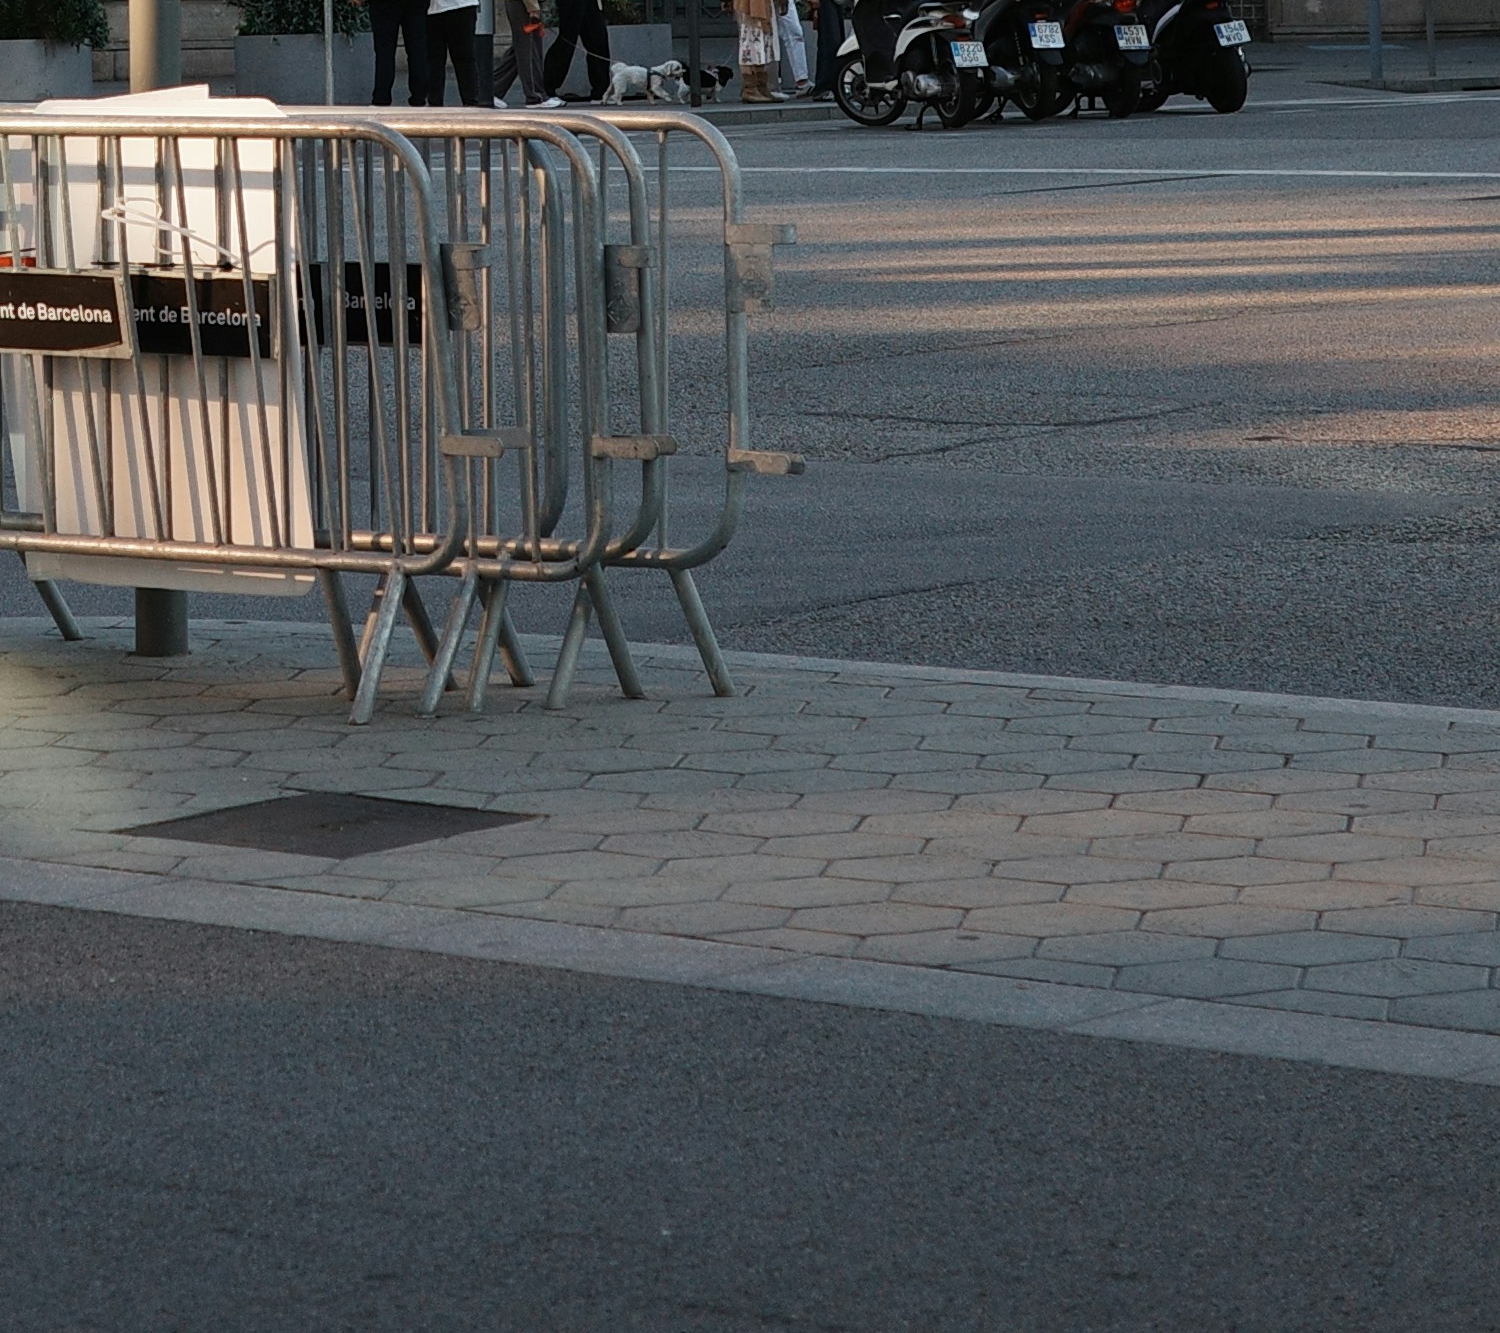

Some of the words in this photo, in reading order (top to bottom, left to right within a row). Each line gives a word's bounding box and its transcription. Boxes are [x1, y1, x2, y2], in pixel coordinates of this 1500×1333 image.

[19, 304, 36, 321] de
[37, 303, 113, 324] Barcelona
[159, 305, 178, 323] de
